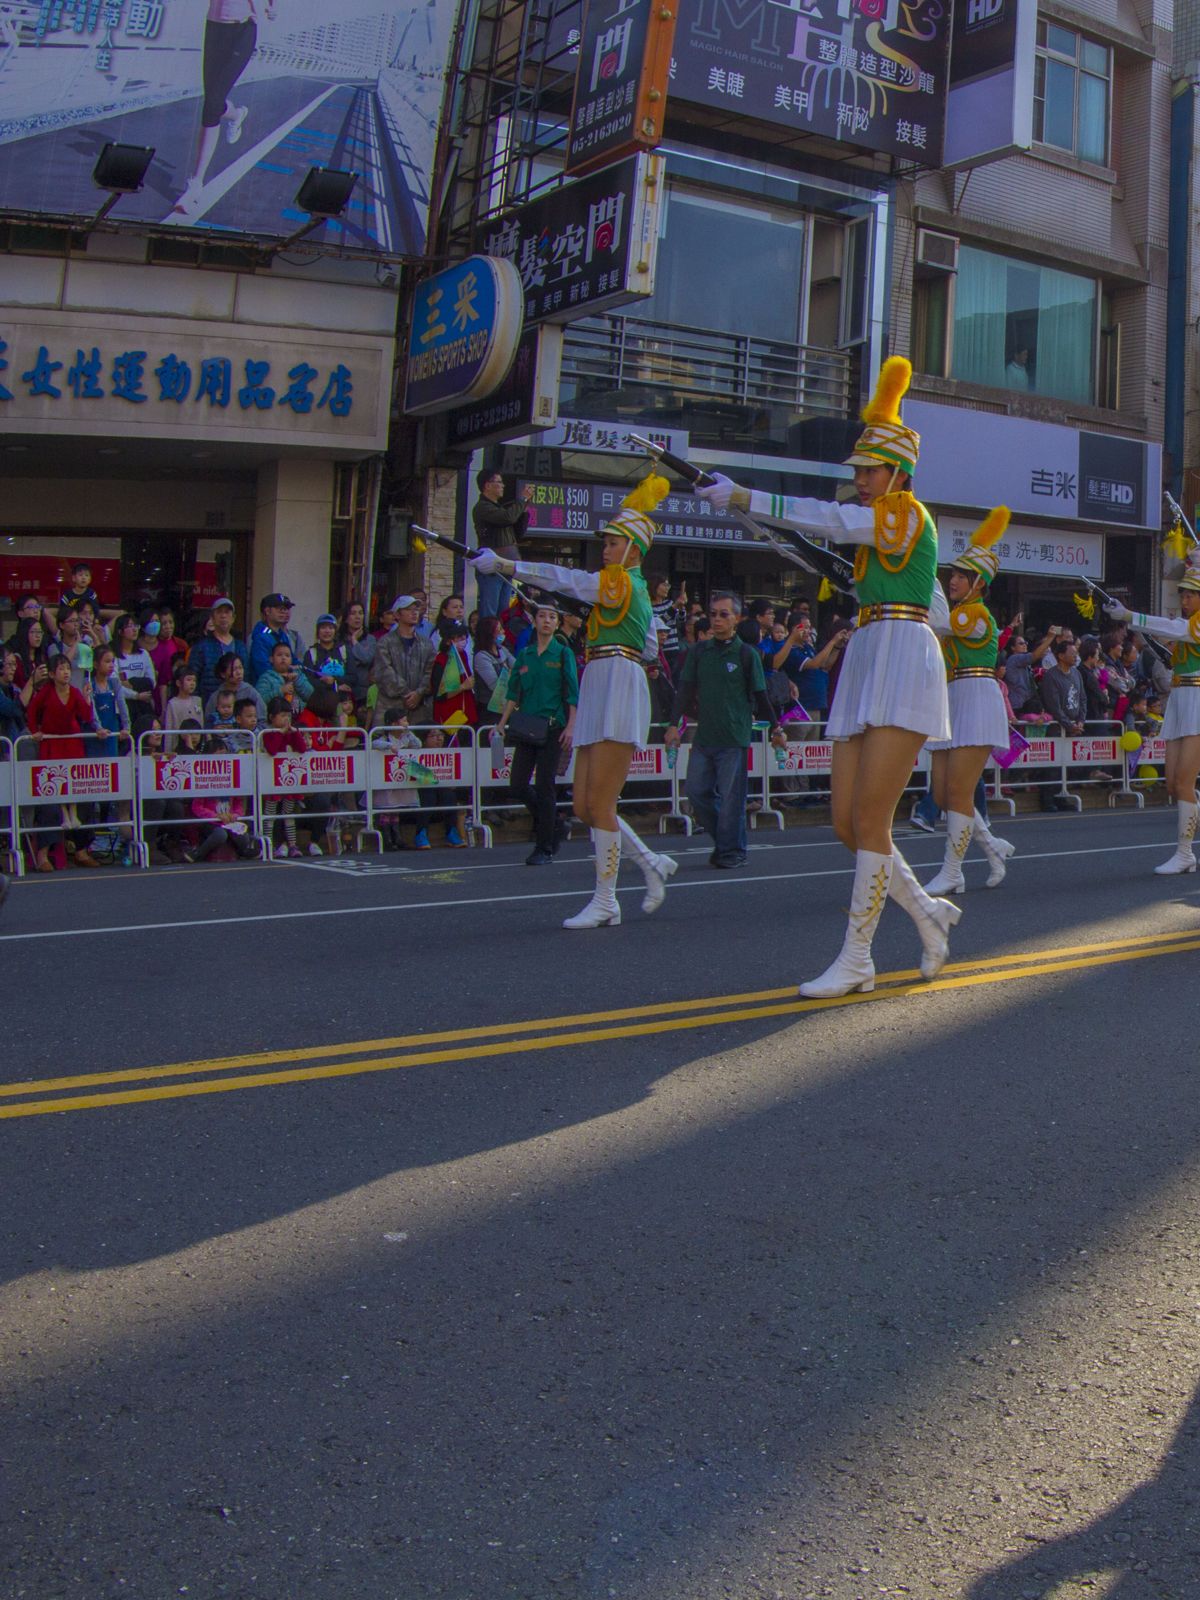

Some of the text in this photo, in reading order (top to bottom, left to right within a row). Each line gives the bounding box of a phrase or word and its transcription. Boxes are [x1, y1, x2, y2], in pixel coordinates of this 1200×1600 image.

[690, 40, 784, 72] MAGIC HAIR SALON
[818, 38, 936, 95] 整體造型沙龍
[707, 66, 745, 98] 美睫
[774, 84, 810, 114] 美甲
[836, 102, 870, 131] 新秘
[896, 119, 927, 150] 接髮
[1031, 468, 1077, 500] 吉米
[566, 487, 590, 507] $500
[1111, 483, 1134, 504] HD
[566, 510, 590, 530] $350
[194, 760, 227, 775] CHIAYI
[310, 756, 341, 771] CHIAYI
[419, 753, 449, 767] CHIAYI
[71, 763, 105, 779] CHIAYI
[195, 775, 231, 783] International
[72, 780, 109, 788] International
[72, 787, 109, 796] Band Festival
[210, 782, 231, 790] Festival
